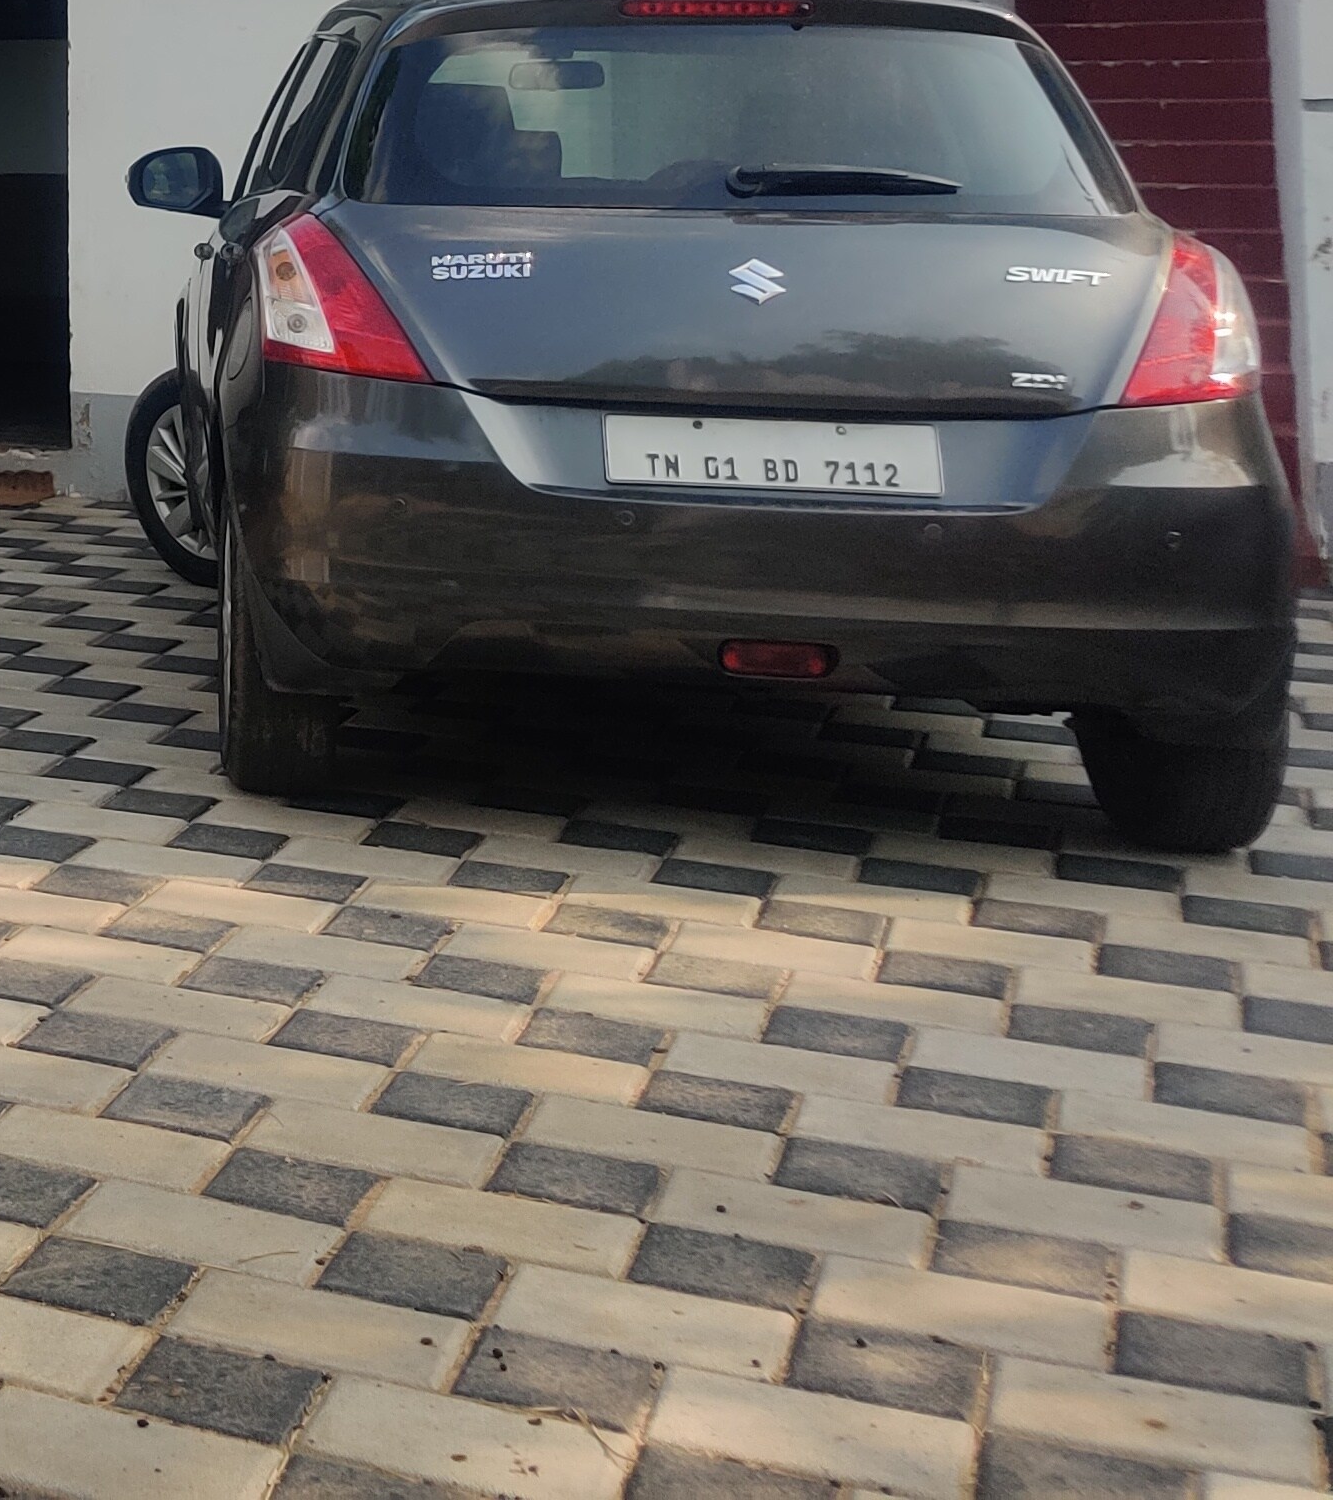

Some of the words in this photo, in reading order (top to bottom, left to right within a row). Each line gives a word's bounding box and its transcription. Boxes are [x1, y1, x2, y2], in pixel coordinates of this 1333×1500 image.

[431, 252, 532, 266] MARUTI
[432, 263, 531, 280] SUZUKI
[1005, 266, 1111, 286] SWIFT
[645, 453, 680, 478] TN
[763, 458, 799, 483] BD
[824, 460, 900, 488] 7112
